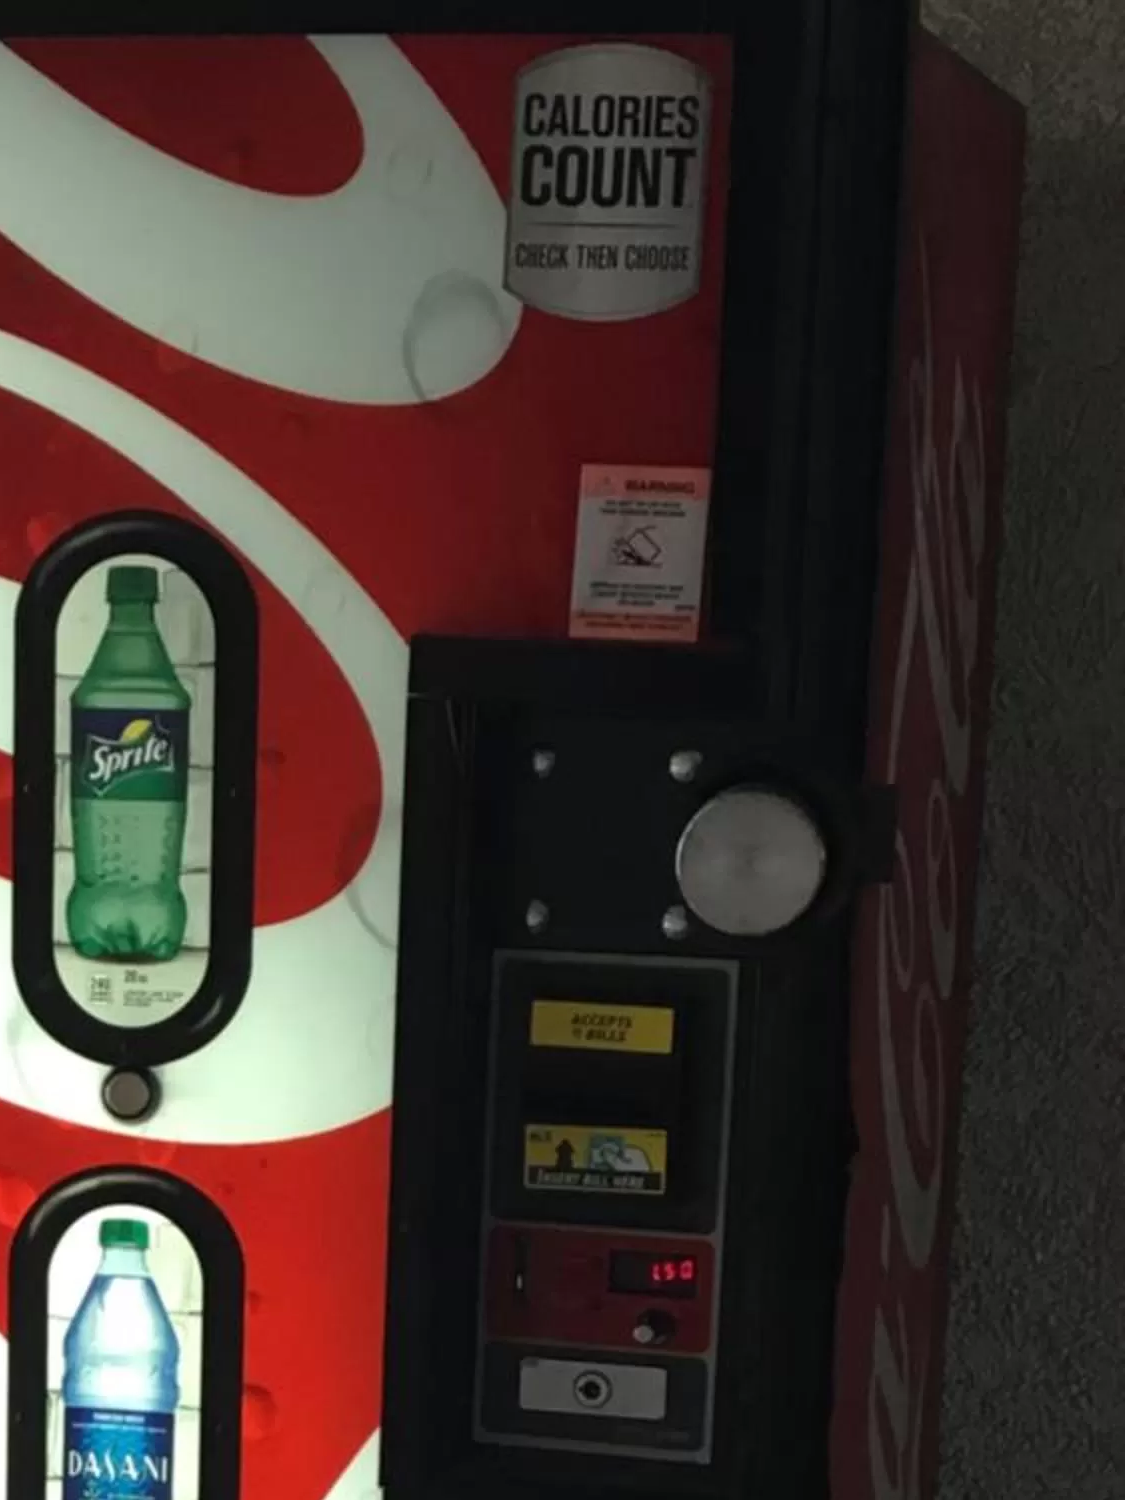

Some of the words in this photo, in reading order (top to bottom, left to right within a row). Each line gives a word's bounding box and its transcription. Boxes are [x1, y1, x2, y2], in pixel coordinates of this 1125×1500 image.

[523, 92, 700, 140] CALORIES
[520, 144, 697, 209] COUNT
[515, 243, 568, 269] CHECK
[577, 244, 618, 270] THEN
[624, 245, 690, 272] CHOOSE
[625, 479, 695, 494] WARNING
[89, 737, 169, 782] Sprite
[67, 1447, 169, 1485] DASANI
